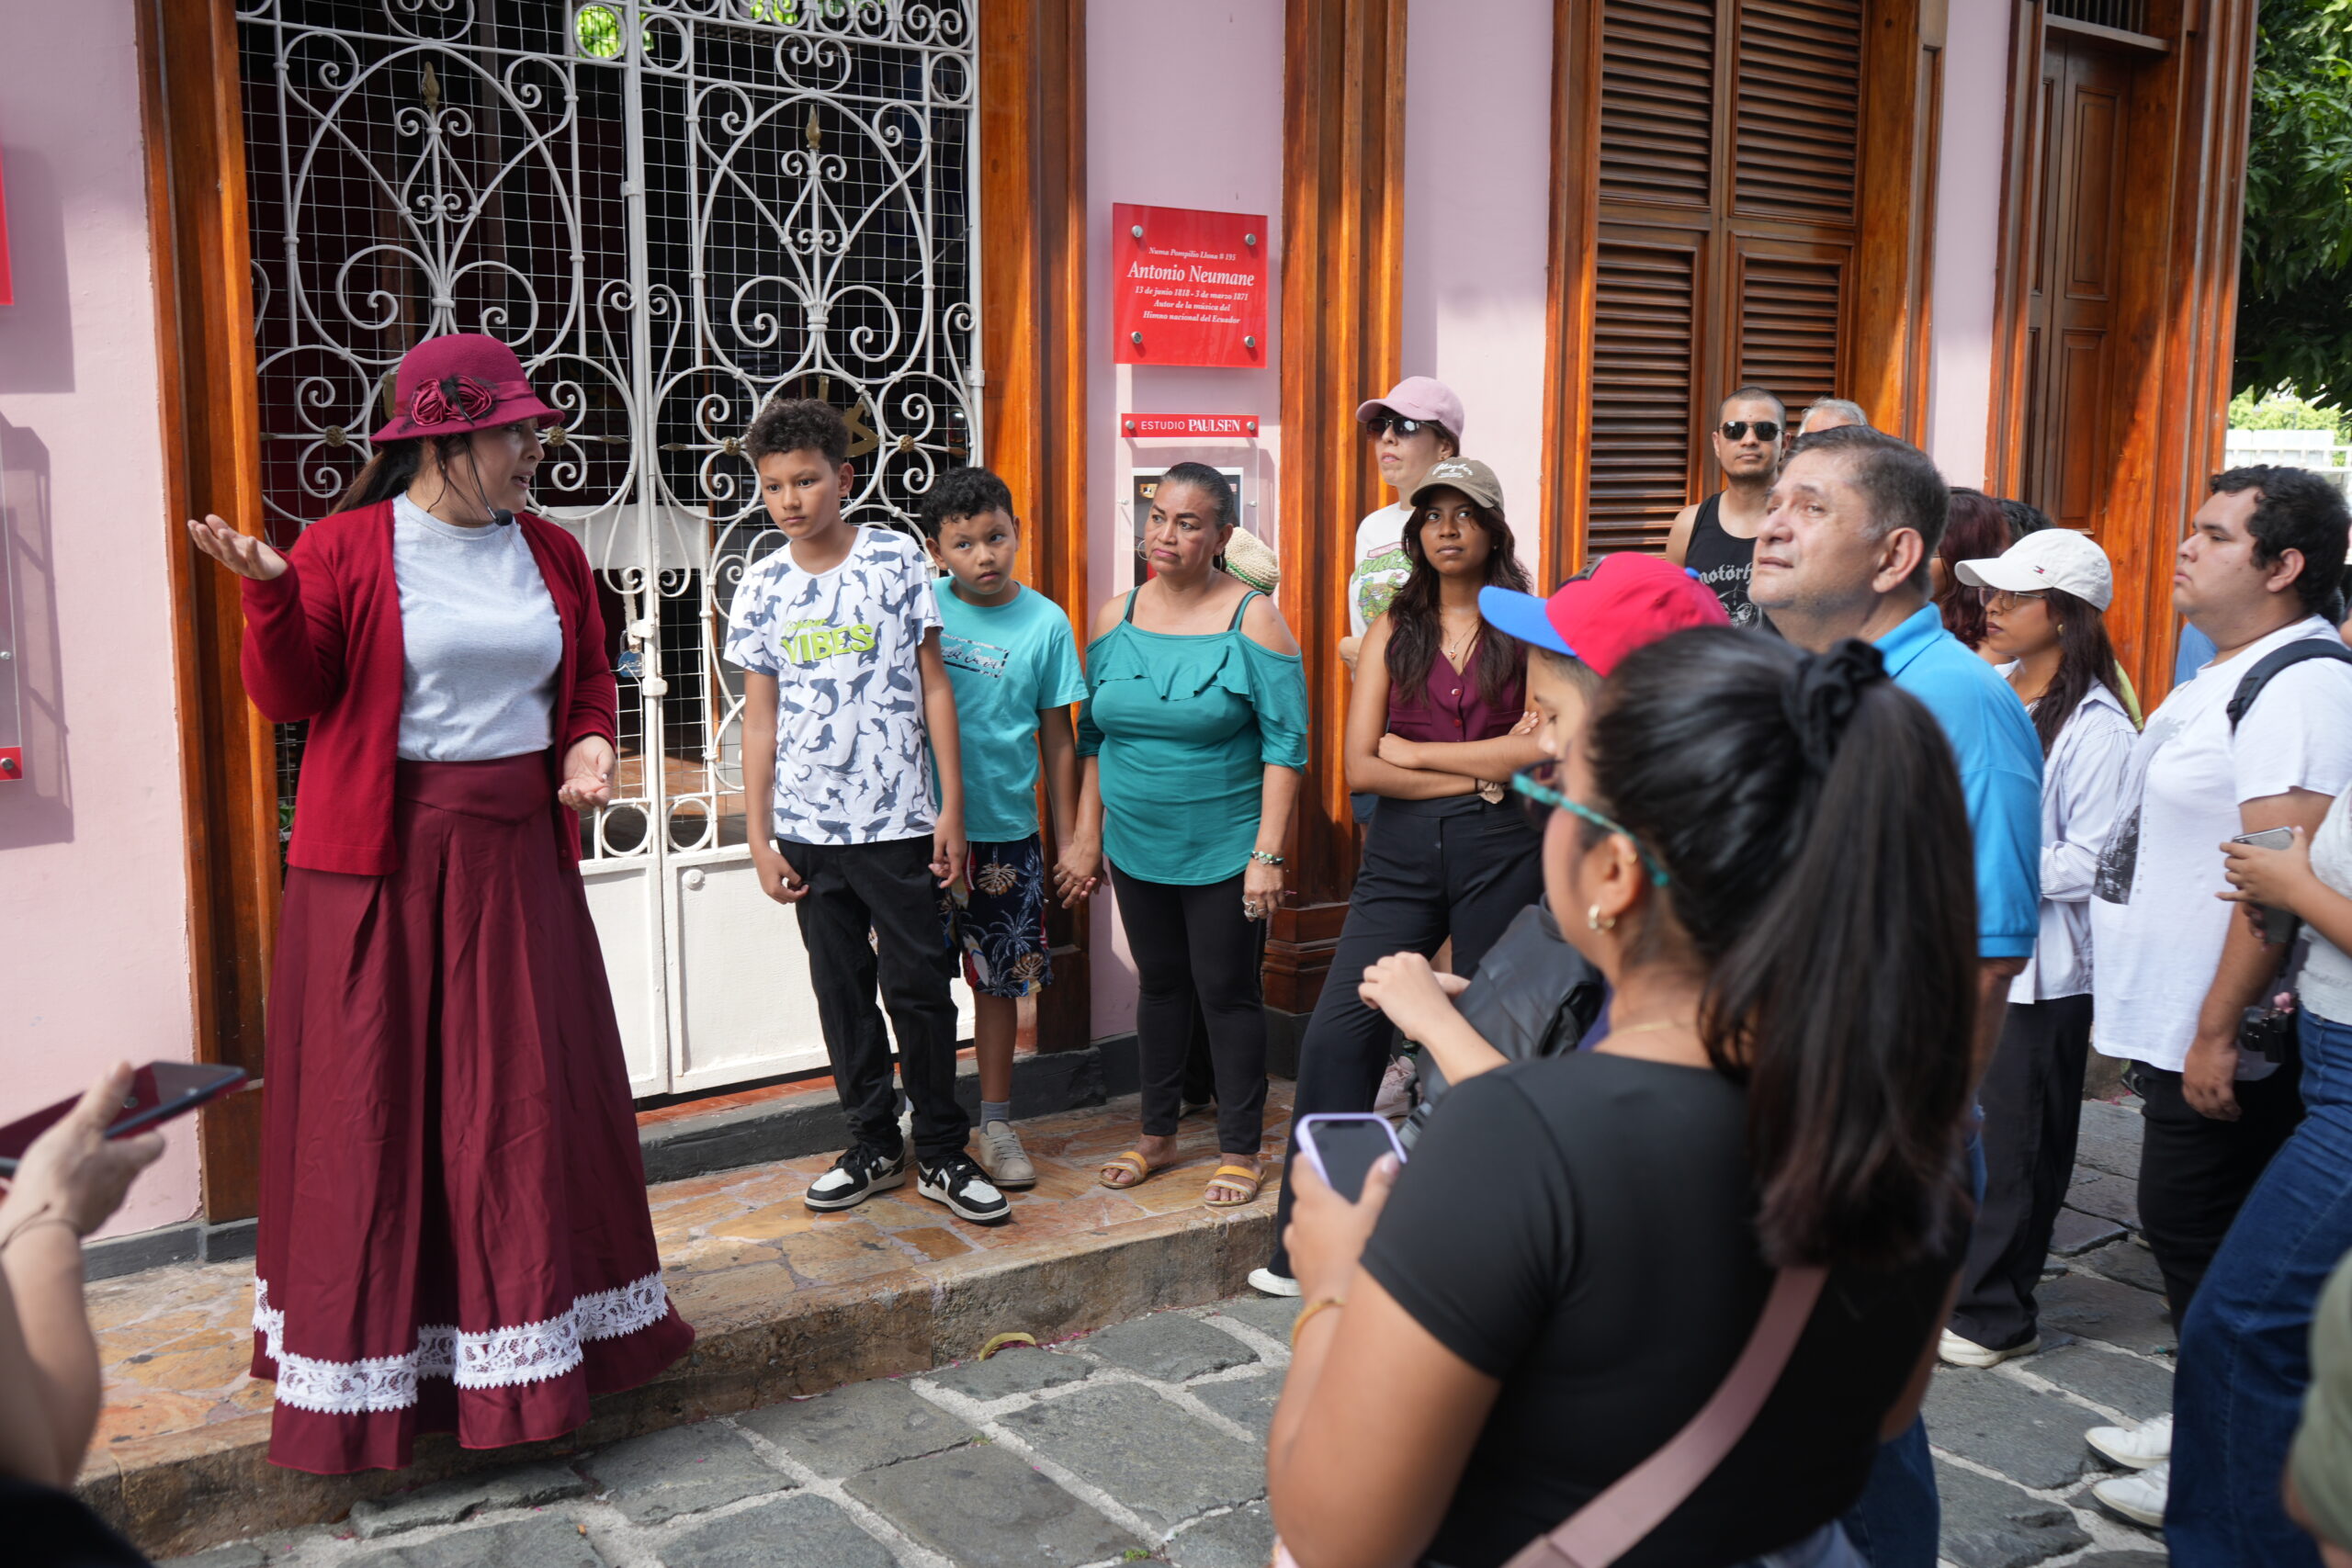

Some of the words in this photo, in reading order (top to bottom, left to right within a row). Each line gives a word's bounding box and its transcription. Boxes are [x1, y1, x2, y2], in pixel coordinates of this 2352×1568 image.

[1148, 247, 1169, 256] Numa
[1170, 249, 1199, 259] Pompilio
[1127, 261, 1185, 281] Antonio
[1188, 265, 1255, 287] Neumane
[1135, 286, 1144, 294] 13
[1145, 287, 1153, 295] de
[1153, 288, 1173, 298] junio
[1174, 288, 1191, 297] 1818
[1194, 289, 1200, 298] 3
[1201, 290, 1209, 299] de
[1210, 292, 1232, 300] marzo
[1233, 292, 1248, 301] 1871
[1154, 299, 1174, 309] Autor
[1175, 300, 1184, 309] de
[1184, 300, 1193, 310] la
[1193, 302, 1219, 311] música
[1220, 303, 1231, 311] del
[1143, 310, 1168, 320] Himno
[1169, 312, 1199, 321] nacional
[1200, 313, 1210, 322] del
[1212, 314, 1241, 324] Ecuador
[1141, 421, 1185, 430] ESTUDIO
[1188, 419, 1241, 433] PAULSEN
[781, 624, 876, 665] VIBES
